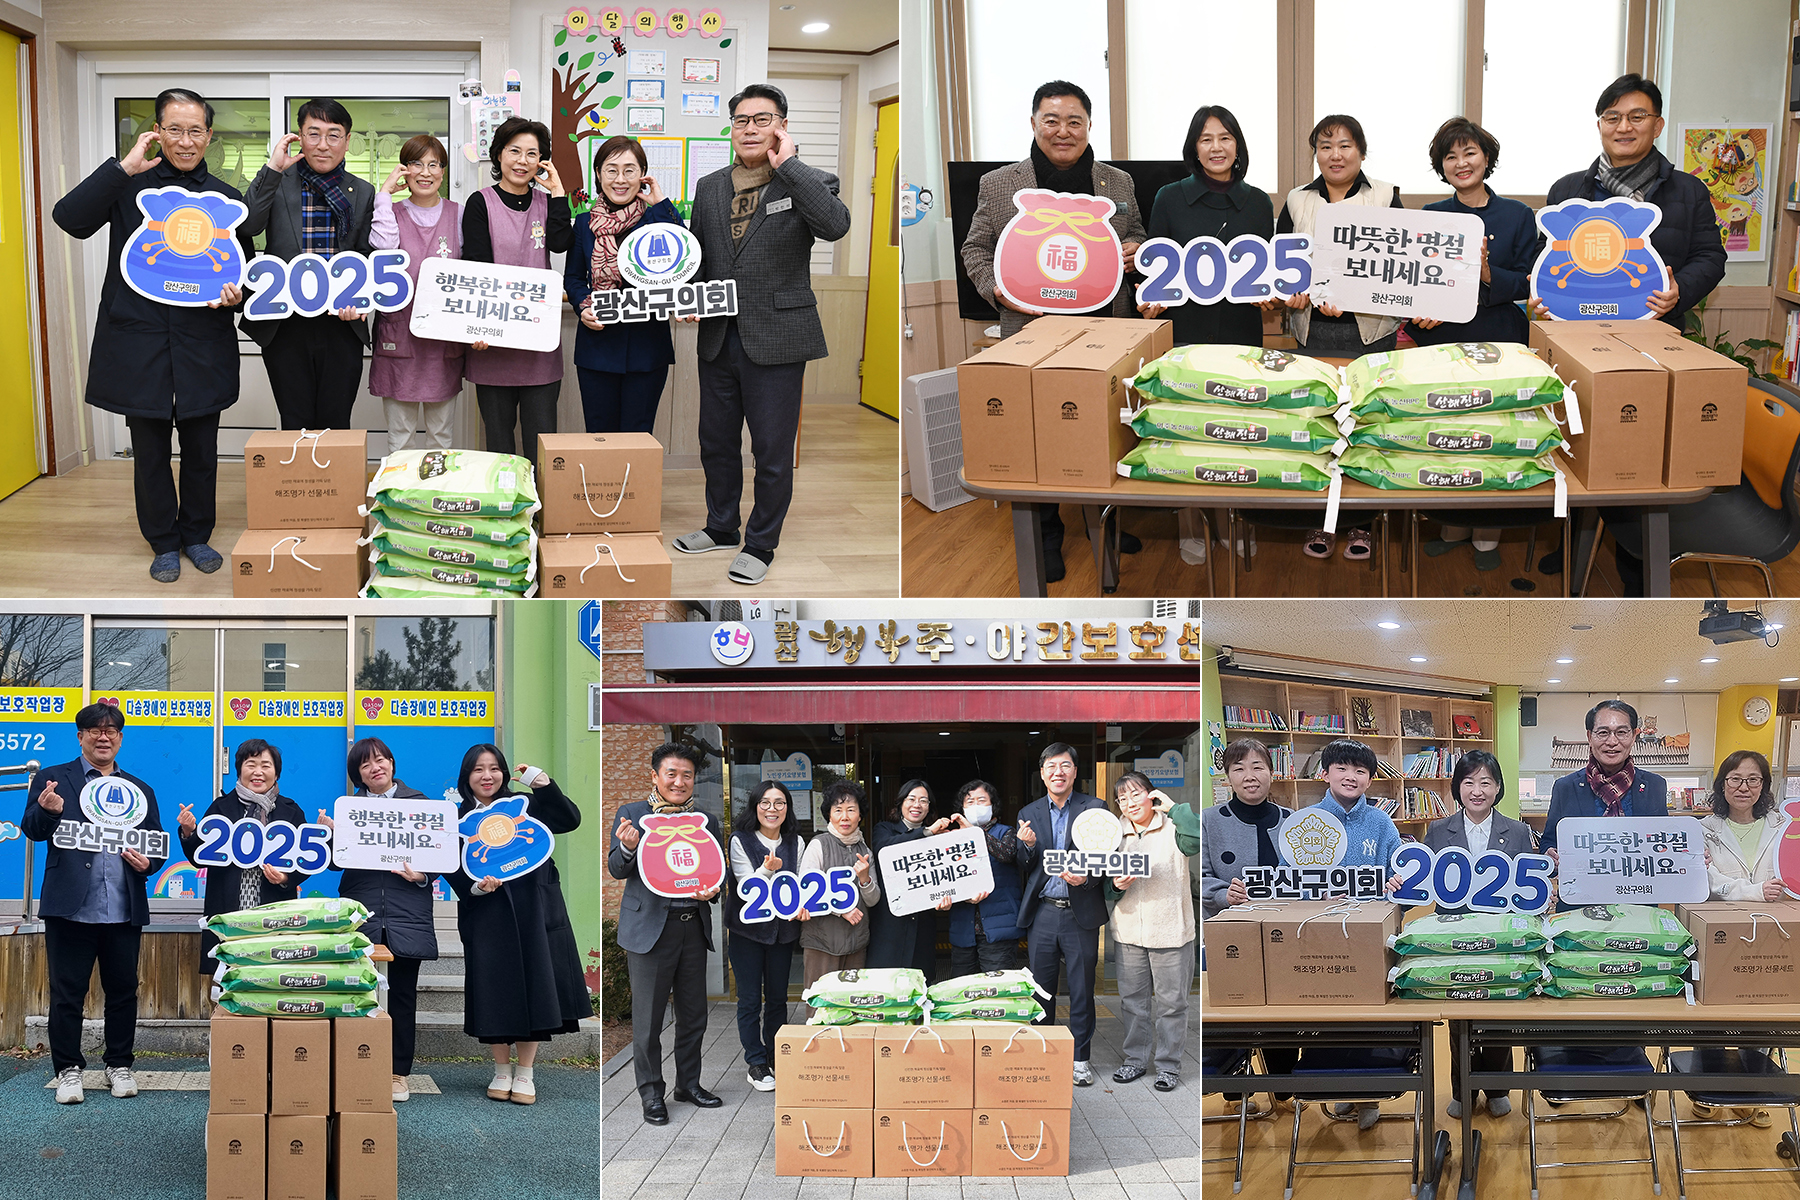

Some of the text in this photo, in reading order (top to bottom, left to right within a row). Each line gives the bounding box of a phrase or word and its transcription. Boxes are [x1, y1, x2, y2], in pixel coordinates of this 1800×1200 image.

[176, 218, 202, 245] 福
[1332, 224, 1465, 261] 따뜻한 명절
[1584, 232, 1611, 261] 福
[1046, 244, 1078, 271] 福
[624, 260, 696, 286] GWANGSAN-GU COUNCIL
[1141, 238, 1312, 302] 2025
[164, 281, 200, 294] 광산구의회
[248, 255, 408, 315] 2025
[435, 272, 546, 303] 행복한 명절
[1041, 289, 1076, 299] 광산구의회
[1371, 292, 1413, 307] 광산구의회
[593, 282, 736, 322] 광산구의회
[1580, 304, 1618, 314] 광산구의회
[466, 325, 504, 338] 광산구의회
[1213, 384, 1258, 401] 산해진미
[1435, 396, 1484, 408] 산해진미
[1212, 426, 1258, 441] 산해진미
[1435, 437, 1484, 449] 산해진미
[1203, 470, 1249, 482] 산해진미
[1427, 474, 1474, 486] 산해진미
[308, 489, 338, 498] 선물세트
[438, 501, 474, 511] 산해진미
[432, 526, 467, 536] 산해진미
[434, 551, 469, 563] 산해진미
[437, 572, 472, 584] 산해진미
[751, 607, 761, 620] LG
[774, 621, 800, 662] 광산
[0, 696, 65, 713] 보호작업장
[126, 699, 212, 718] 다솜장애인 보호작업장
[259, 699, 344, 718] 다솜장애인 보호작업장
[390, 699, 487, 718] 다솜장애인 보호작업장
[85, 805, 143, 826] GWANGSAN-GU COUNCIL
[348, 808, 444, 832] 행복한 명절
[486, 821, 510, 839] 福
[55, 822, 168, 857] 광산구의회
[200, 818, 330, 871] 2025
[1304, 836, 1323, 847] 의회
[1573, 832, 1689, 854] 따뜻한 명절
[1362, 838, 1377, 856] NY
[380, 854, 412, 864] 광산구의회
[671, 849, 694, 867] 福
[892, 840, 977, 874] 따뜻한 명절
[1045, 852, 1150, 876] 광산구의회
[674, 879, 700, 888] 광산구의회
[1245, 868, 1383, 898] 광산구의회
[1393, 847, 1549, 911] 2025
[740, 869, 855, 920] 2025
[929, 888, 956, 902] 광산구의회
[1615, 885, 1653, 895] 광산구의회
[1458, 942, 1490, 950] 산해진미
[1610, 940, 1643, 950] 산해진미
[277, 950, 312, 960] 산해진미
[1326, 965, 1357, 973] 선물세트
[1604, 966, 1637, 974] 산해진미
[1764, 965, 1794, 973] 선물세트
[285, 977, 321, 986] 산해진미
[1455, 974, 1488, 982] 산해진미
[1452, 989, 1484, 999] 산해진미
[1599, 986, 1631, 995] 산해진미
[282, 1004, 319, 1013] 산해진미
